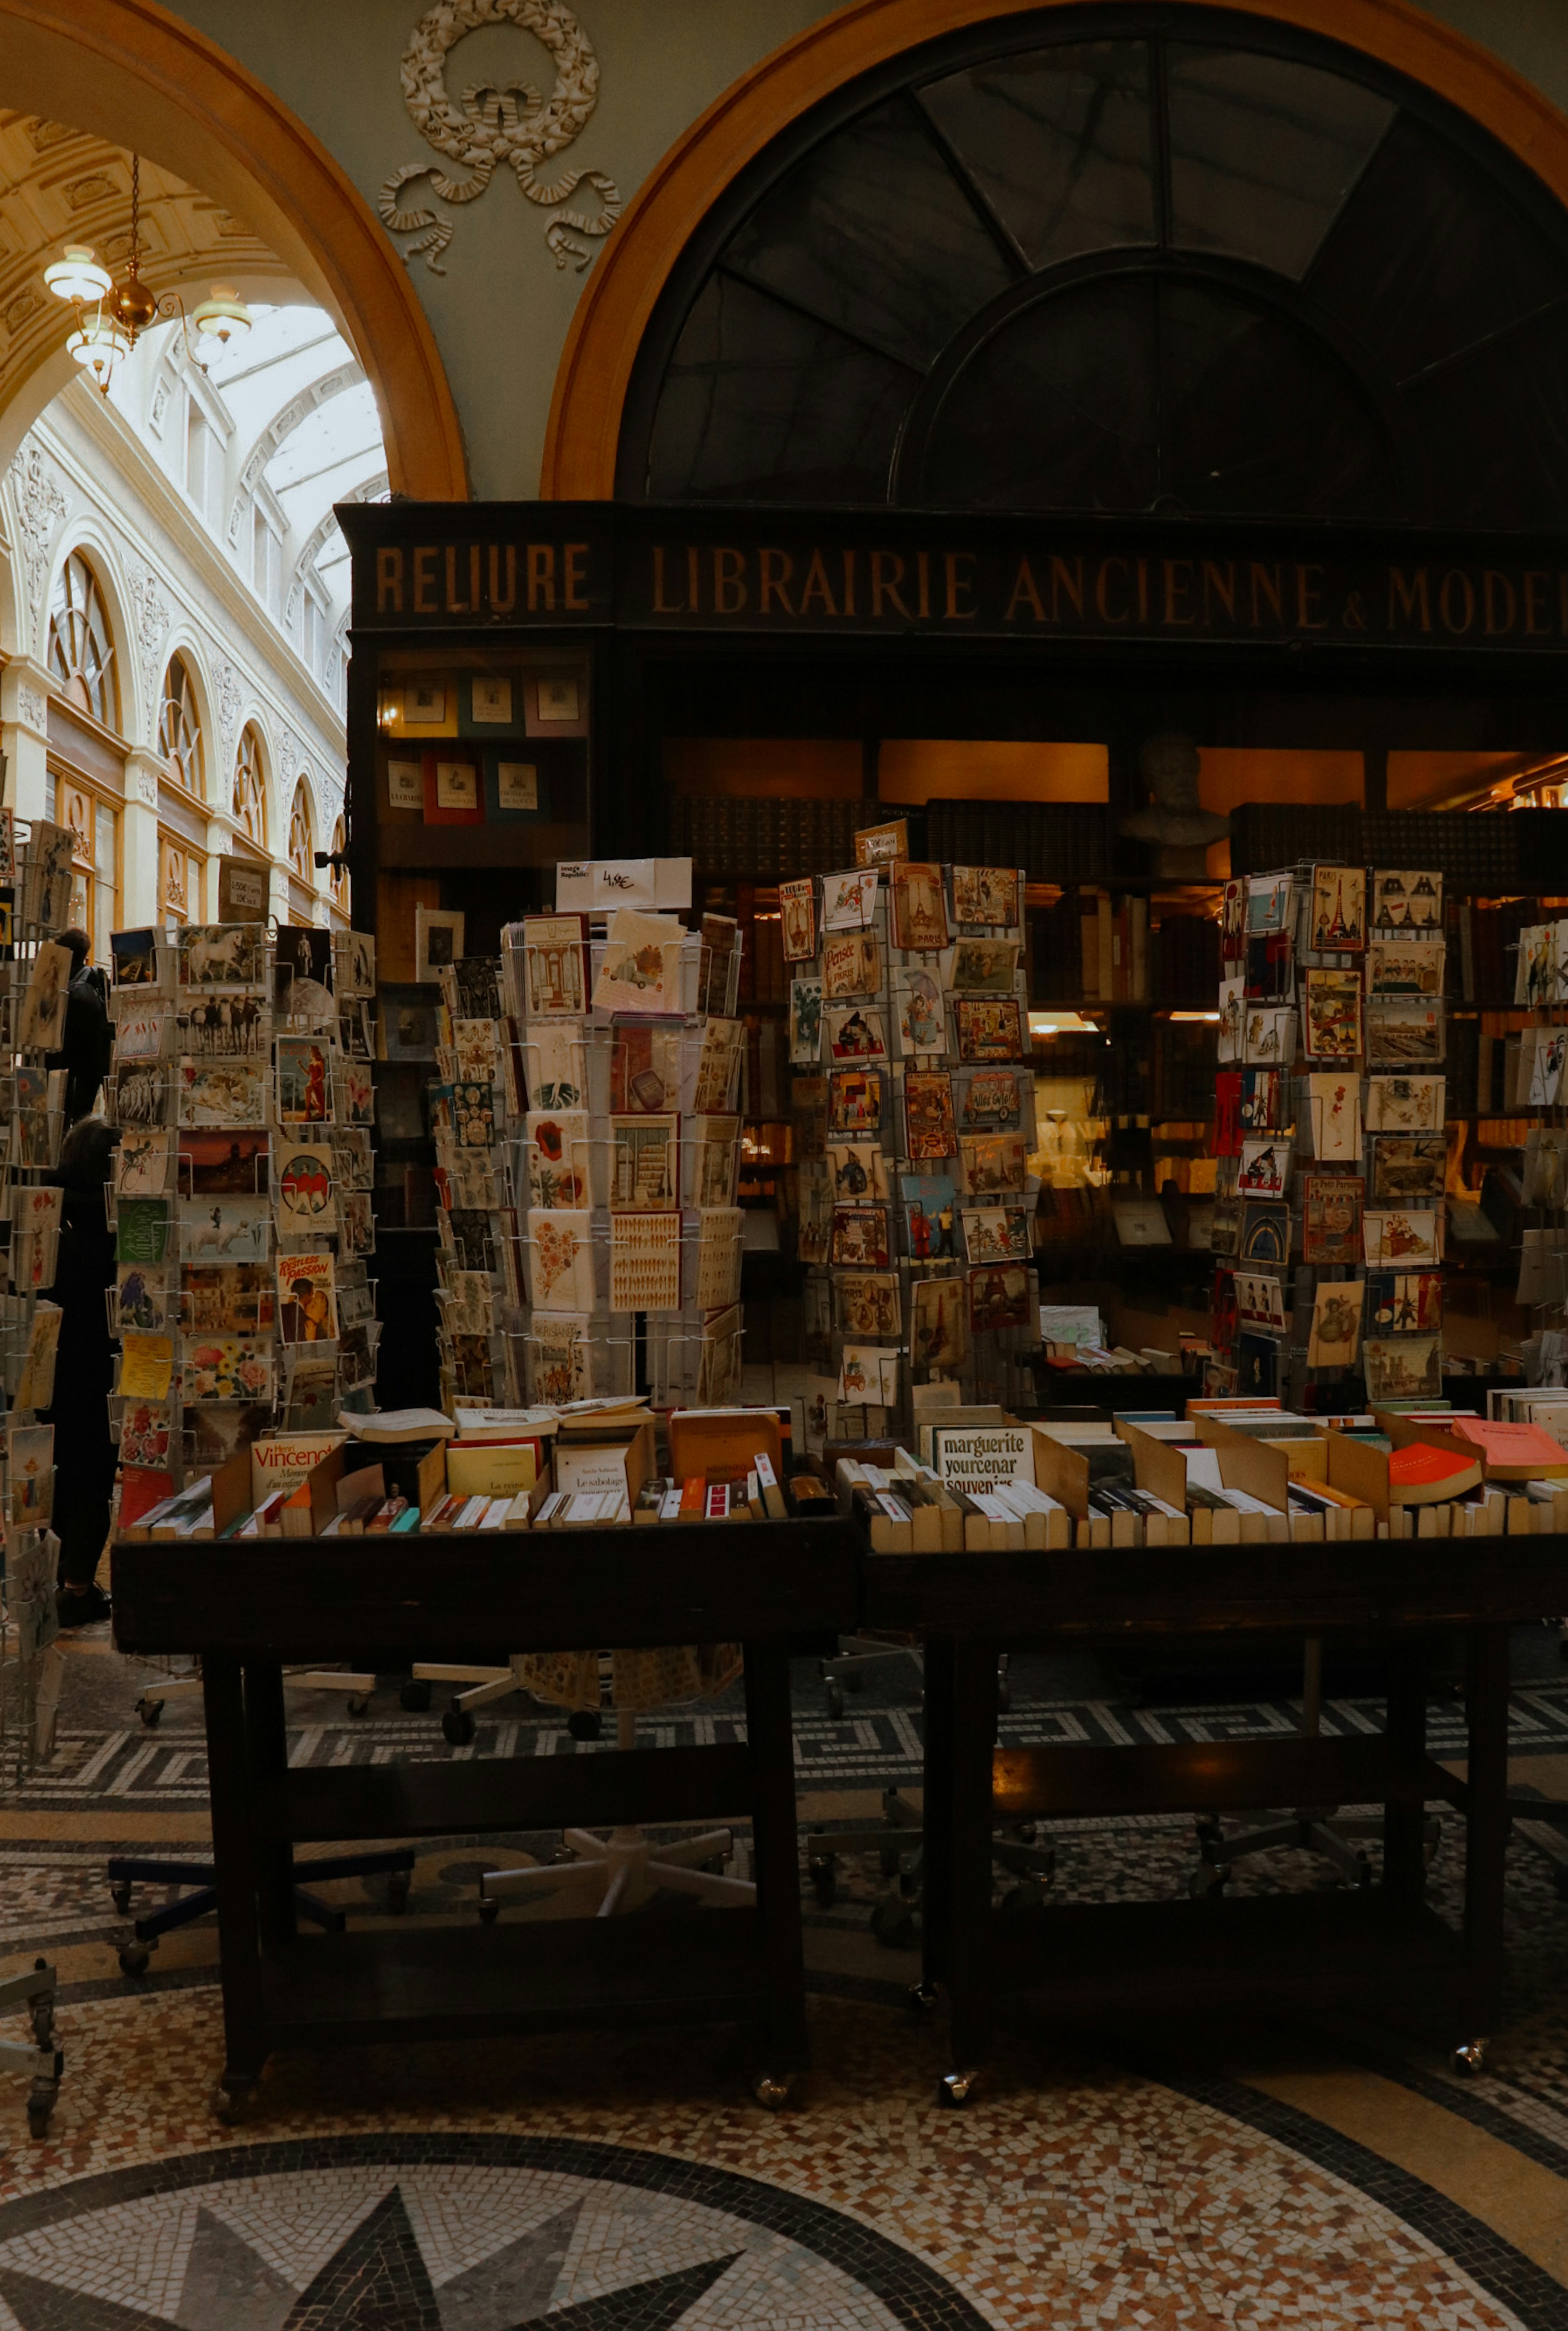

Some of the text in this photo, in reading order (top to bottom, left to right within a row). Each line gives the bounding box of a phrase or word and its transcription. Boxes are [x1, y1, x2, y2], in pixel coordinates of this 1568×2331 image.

[376, 543, 591, 614] RELIURE
[652, 545, 980, 621] LIBRAIRIE
[1003, 554, 1330, 629] ANCIENNE
[1342, 590, 1369, 631] &
[1319, 871, 1337, 880] PARIS
[918, 935, 941, 944] PARIS
[279, 1255, 320, 1277] RESTLESS
[286, 1262, 328, 1286] PASSION
[274, 1444, 295, 1453] Henri
[944, 1433, 1024, 1458] marguerite
[945, 1459, 1017, 1477] yourcenar
[490, 1481, 501, 1490] La
[577, 1478, 587, 1487] Le
